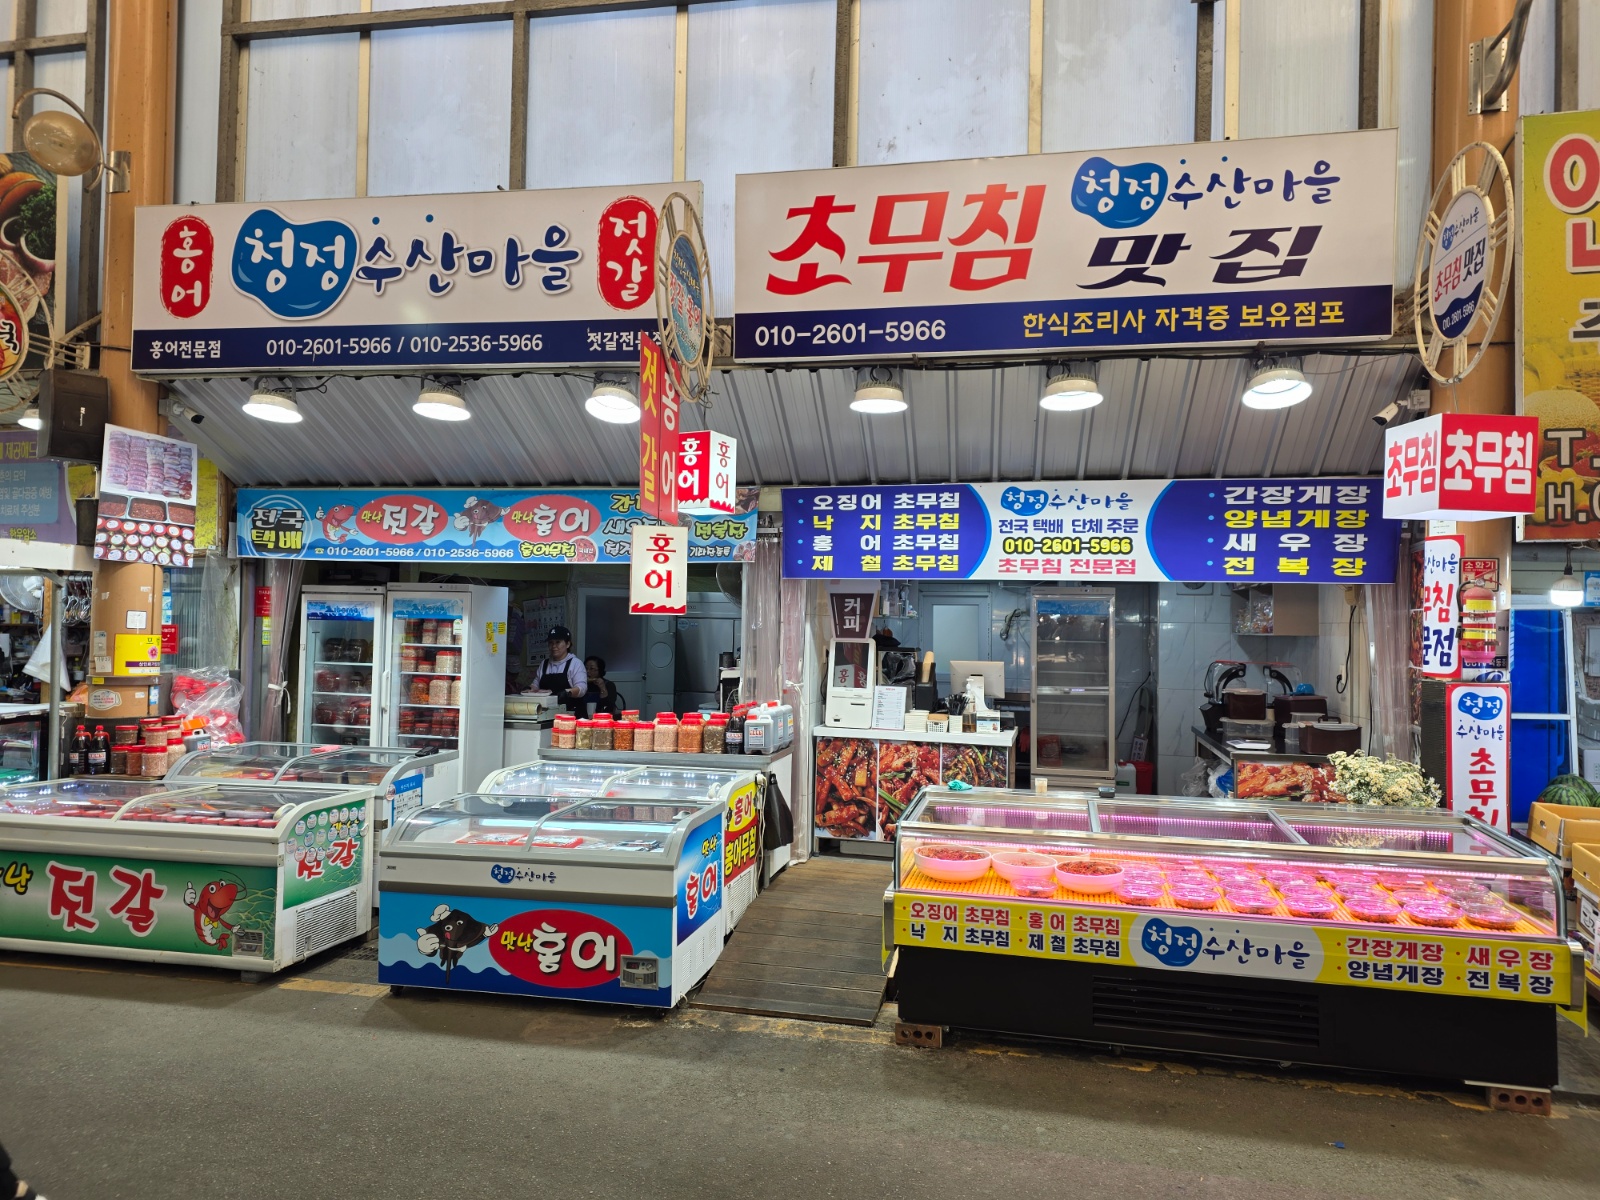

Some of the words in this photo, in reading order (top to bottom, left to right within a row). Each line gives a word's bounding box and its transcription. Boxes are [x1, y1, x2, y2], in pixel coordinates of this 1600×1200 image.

[765, 183, 1047, 296] 초무침
[171, 225, 203, 307] 홍어
[607, 211, 648, 302] 젓갈
[1463, 237, 1487, 283] 맛집
[1434, 254, 1463, 303] 초무침
[1023, 308, 1146, 338] 한식조리사
[1155, 303, 1230, 332] 자격증
[1239, 301, 1345, 329] 보유점포
[266, 337, 392, 357] 010-2601-5966
[410, 334, 543, 354] 010-2536-5966
[586, 332, 662, 351] 젓갈전
[755, 319, 947, 347] 010-2601-5966
[149, 339, 222, 360] 홍어전문점
[642, 346, 658, 504] 젓갈
[662, 367, 679, 513] 홍어
[678, 437, 703, 496] 홍어
[715, 440, 732, 499] 홍어
[1386, 430, 1438, 499] 초무침
[1444, 424, 1535, 495] 초무침
[611, 493, 640, 512] 간
[812, 493, 882, 511] 오징어
[893, 492, 960, 509] 초무침
[1223, 485, 1371, 505] 간장게장
[253, 508, 305, 528] 전국
[382, 504, 440, 536] 젓갈
[533, 504, 590, 536] 홍어
[893, 513, 960, 530] 초무침
[998, 519, 1029, 533] 전국
[1032, 519, 1063, 534] 택배
[1071, 519, 1102, 533] 단체
[1107, 518, 1139, 533] 주문
[1223, 509, 1370, 529] 양념게장
[251, 529, 303, 550] 택배
[519, 541, 577, 557] 홍어무침
[892, 534, 959, 551] 초무침
[1004, 538, 1132, 554] 010-2601-5966
[327, 547, 414, 557] 010-2601-5966
[424, 548, 514, 558] 010-2536-5966
[892, 555, 959, 572] 초무침
[644, 533, 677, 599] 홍어
[998, 558, 1062, 574] 초무침
[1069, 558, 1137, 575] 전문점
[1464, 561, 1494, 570] 소화기
[843, 597, 861, 633] 커피
[1462, 696, 1501, 714] 청정
[1456, 719, 1505, 741] 수산마을
[734, 790, 753, 826] 홍어
[724, 825, 757, 877] 홍어무침
[0, 861, 32, 895] 난
[685, 862, 718, 919] 홍어
[47, 864, 167, 934] 젓갈
[910, 902, 958, 922] 오징어
[965, 907, 1010, 927] 초무침
[1073, 915, 1120, 936] 초무침
[500, 930, 533, 952] 맛난
[532, 921, 616, 973] 홍어
[965, 928, 1010, 948] 초무침
[1073, 938, 1120, 958] 초무침
[1347, 937, 1444, 962] 간장게장
[1348, 960, 1445, 986] 양념게장
